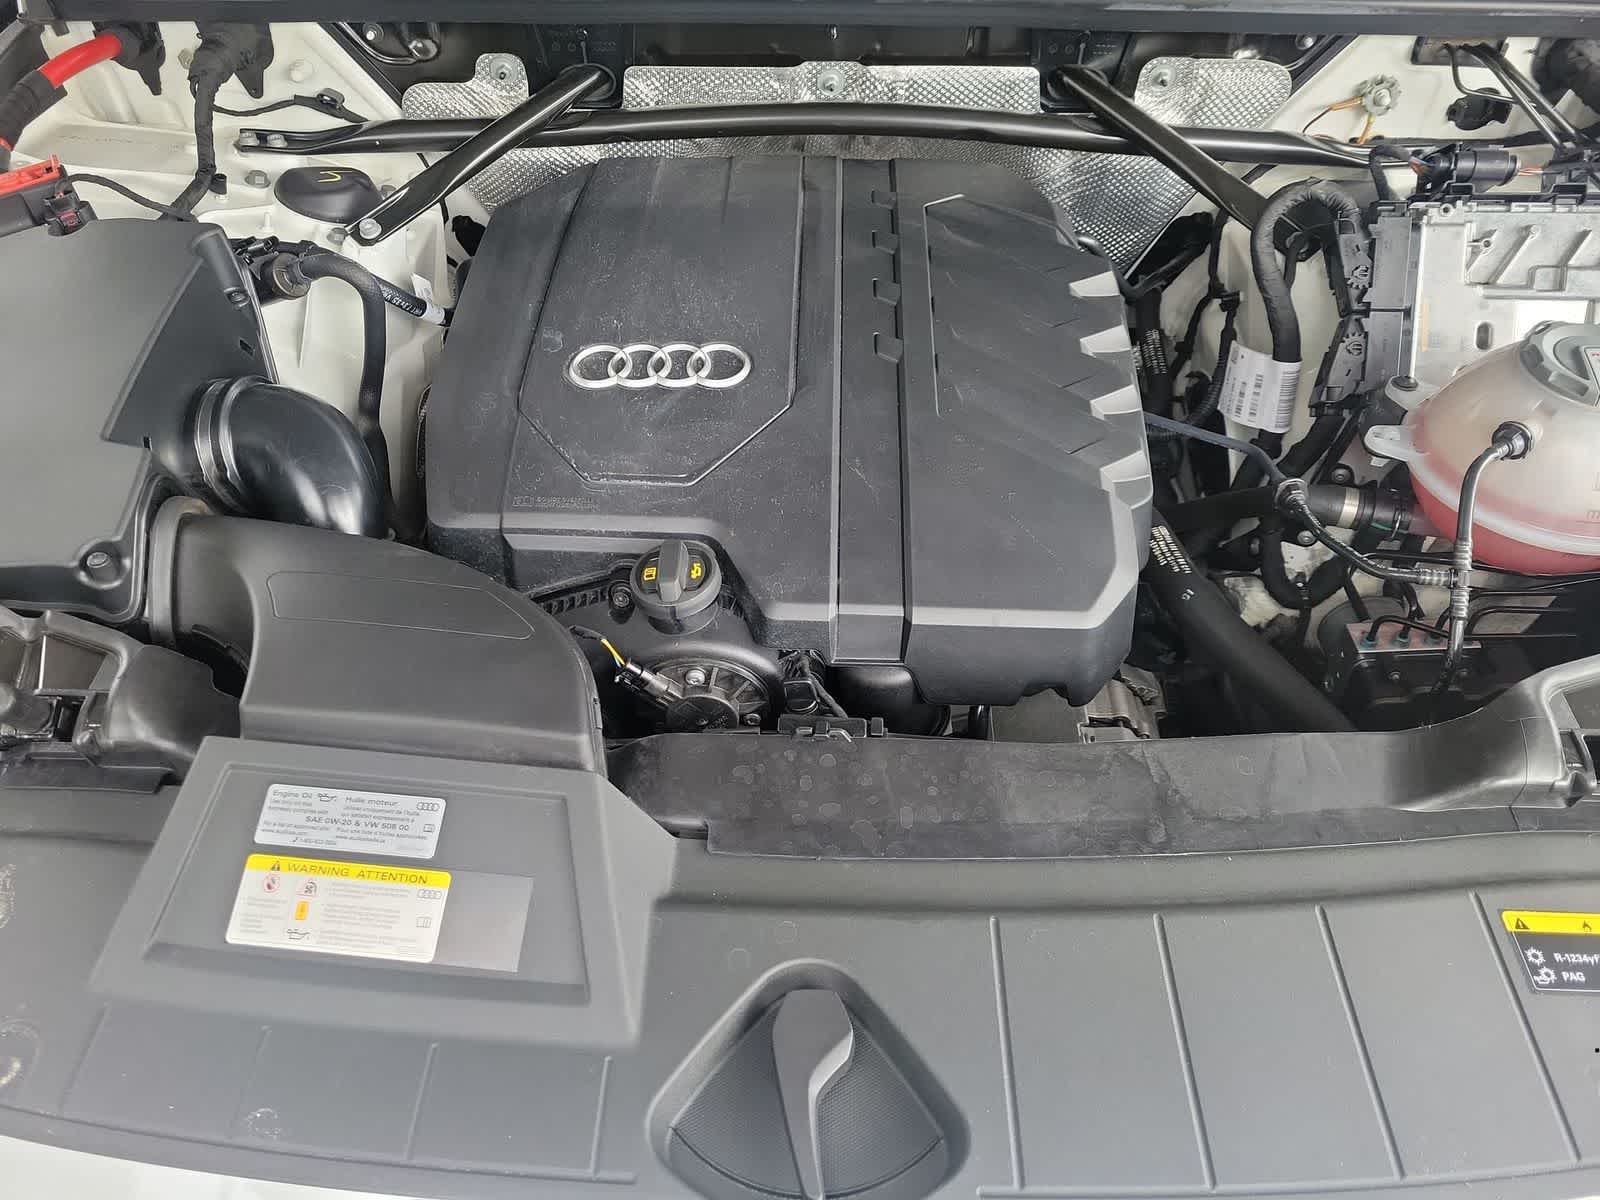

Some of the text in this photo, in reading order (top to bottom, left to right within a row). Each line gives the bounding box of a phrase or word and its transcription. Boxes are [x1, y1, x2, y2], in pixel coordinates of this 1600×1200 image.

[367, 799, 400, 807] moteur
[305, 815, 323, 824] SAE
[363, 821, 379, 829] VW
[287, 862, 428, 885] WARNING ATTENTION
[1561, 971, 1586, 982] PAG
